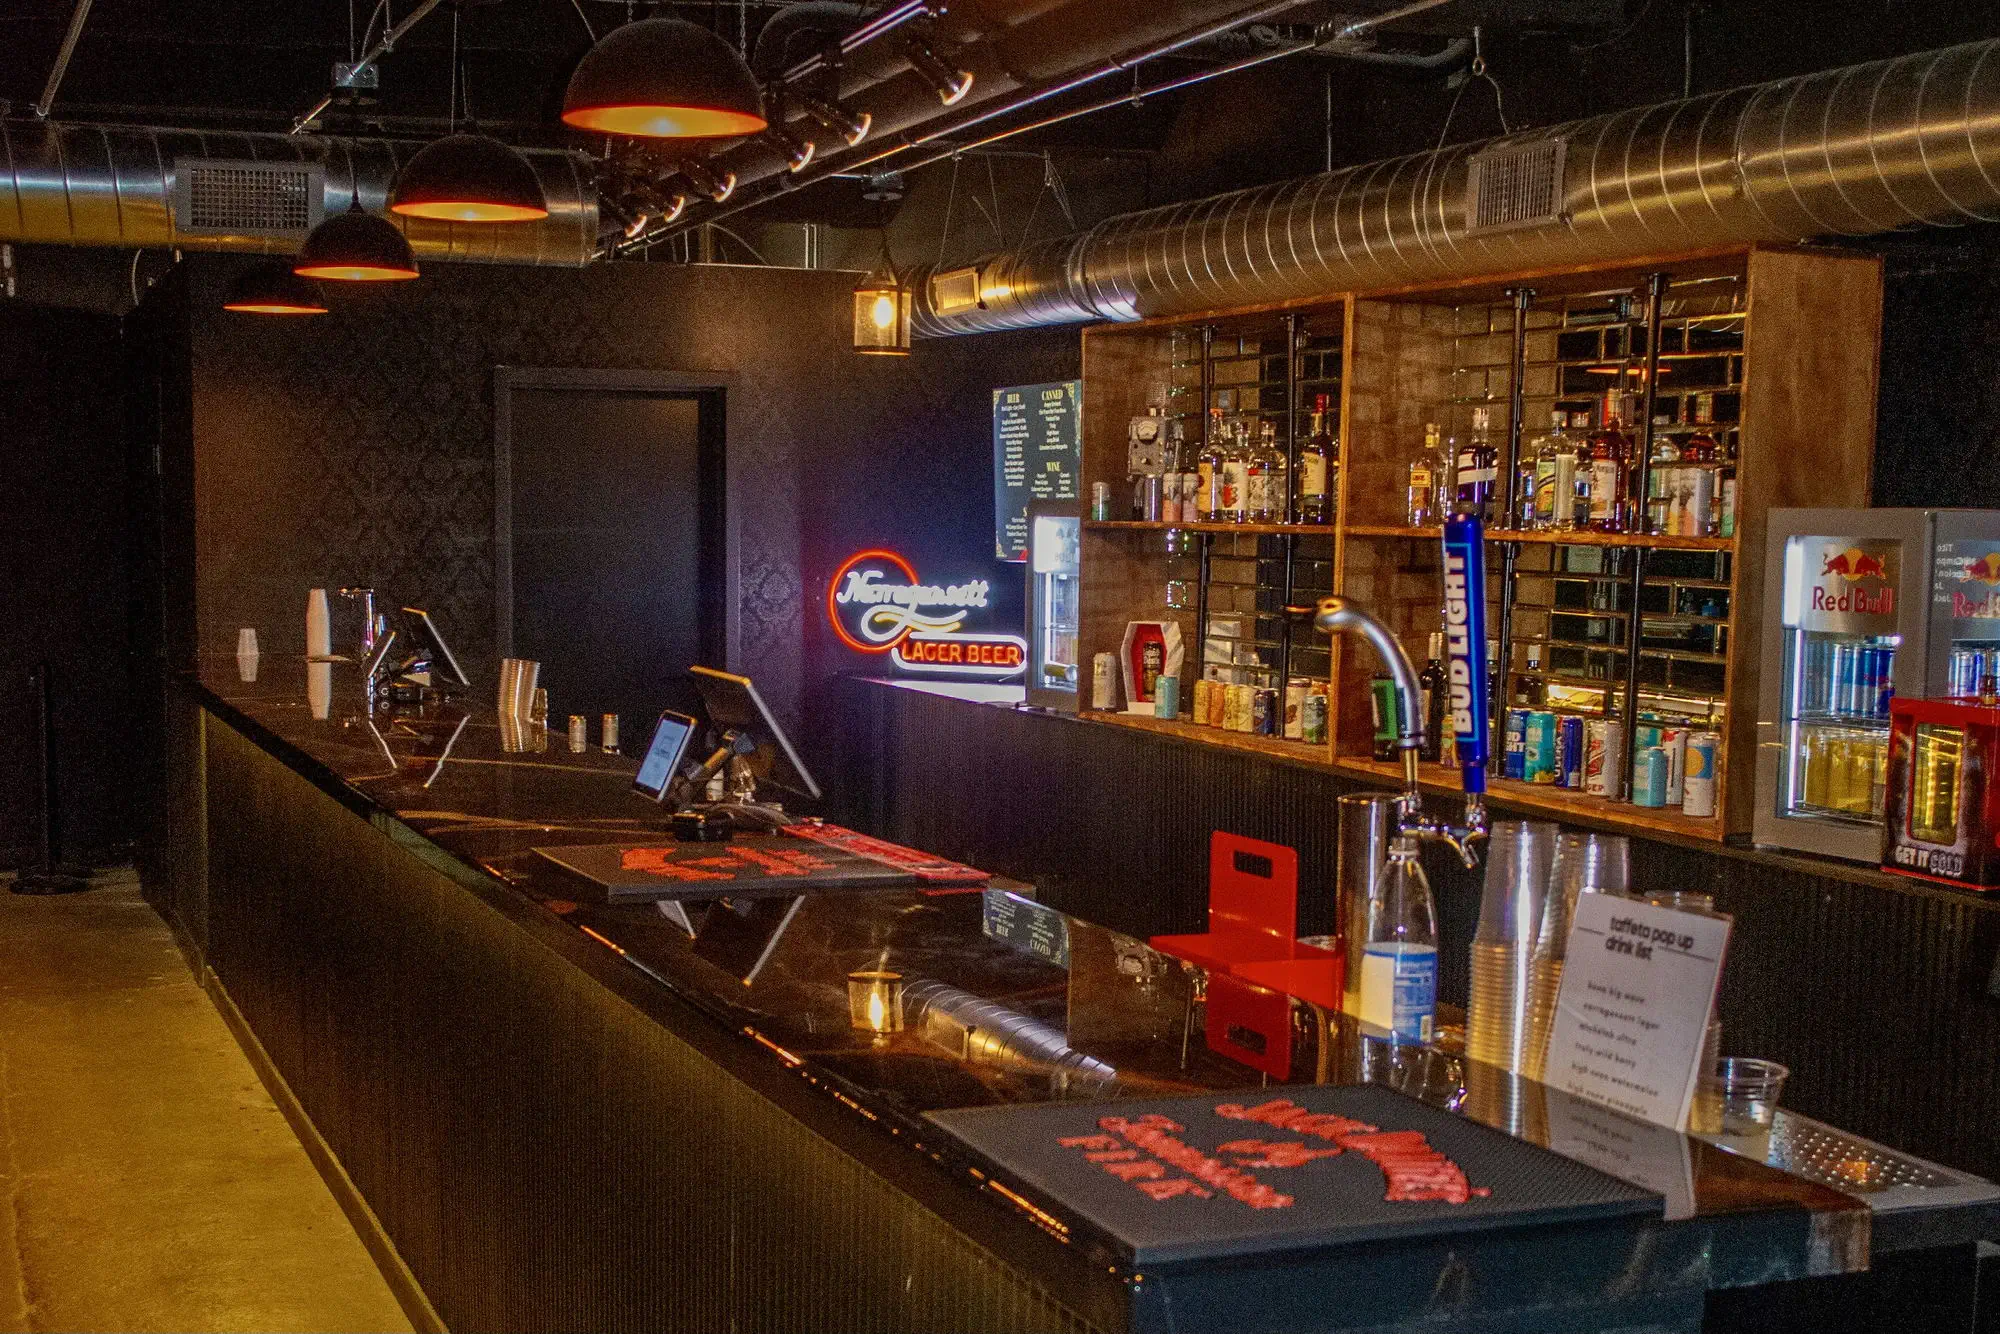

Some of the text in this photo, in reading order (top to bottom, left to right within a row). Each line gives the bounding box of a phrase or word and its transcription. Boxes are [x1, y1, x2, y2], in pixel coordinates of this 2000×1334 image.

[1046, 461, 1061, 472] WINE
[1812, 584, 1893, 614] Red Bull
[901, 641, 1021, 666] LAGER BEER
[1444, 551, 1473, 734] BUD LIGHT
[1895, 844, 1917, 866] GET
[1917, 850, 1930, 868] IT
[1610, 916, 1695, 950] taffeta pop up
[1604, 935, 1653, 961] drink list
